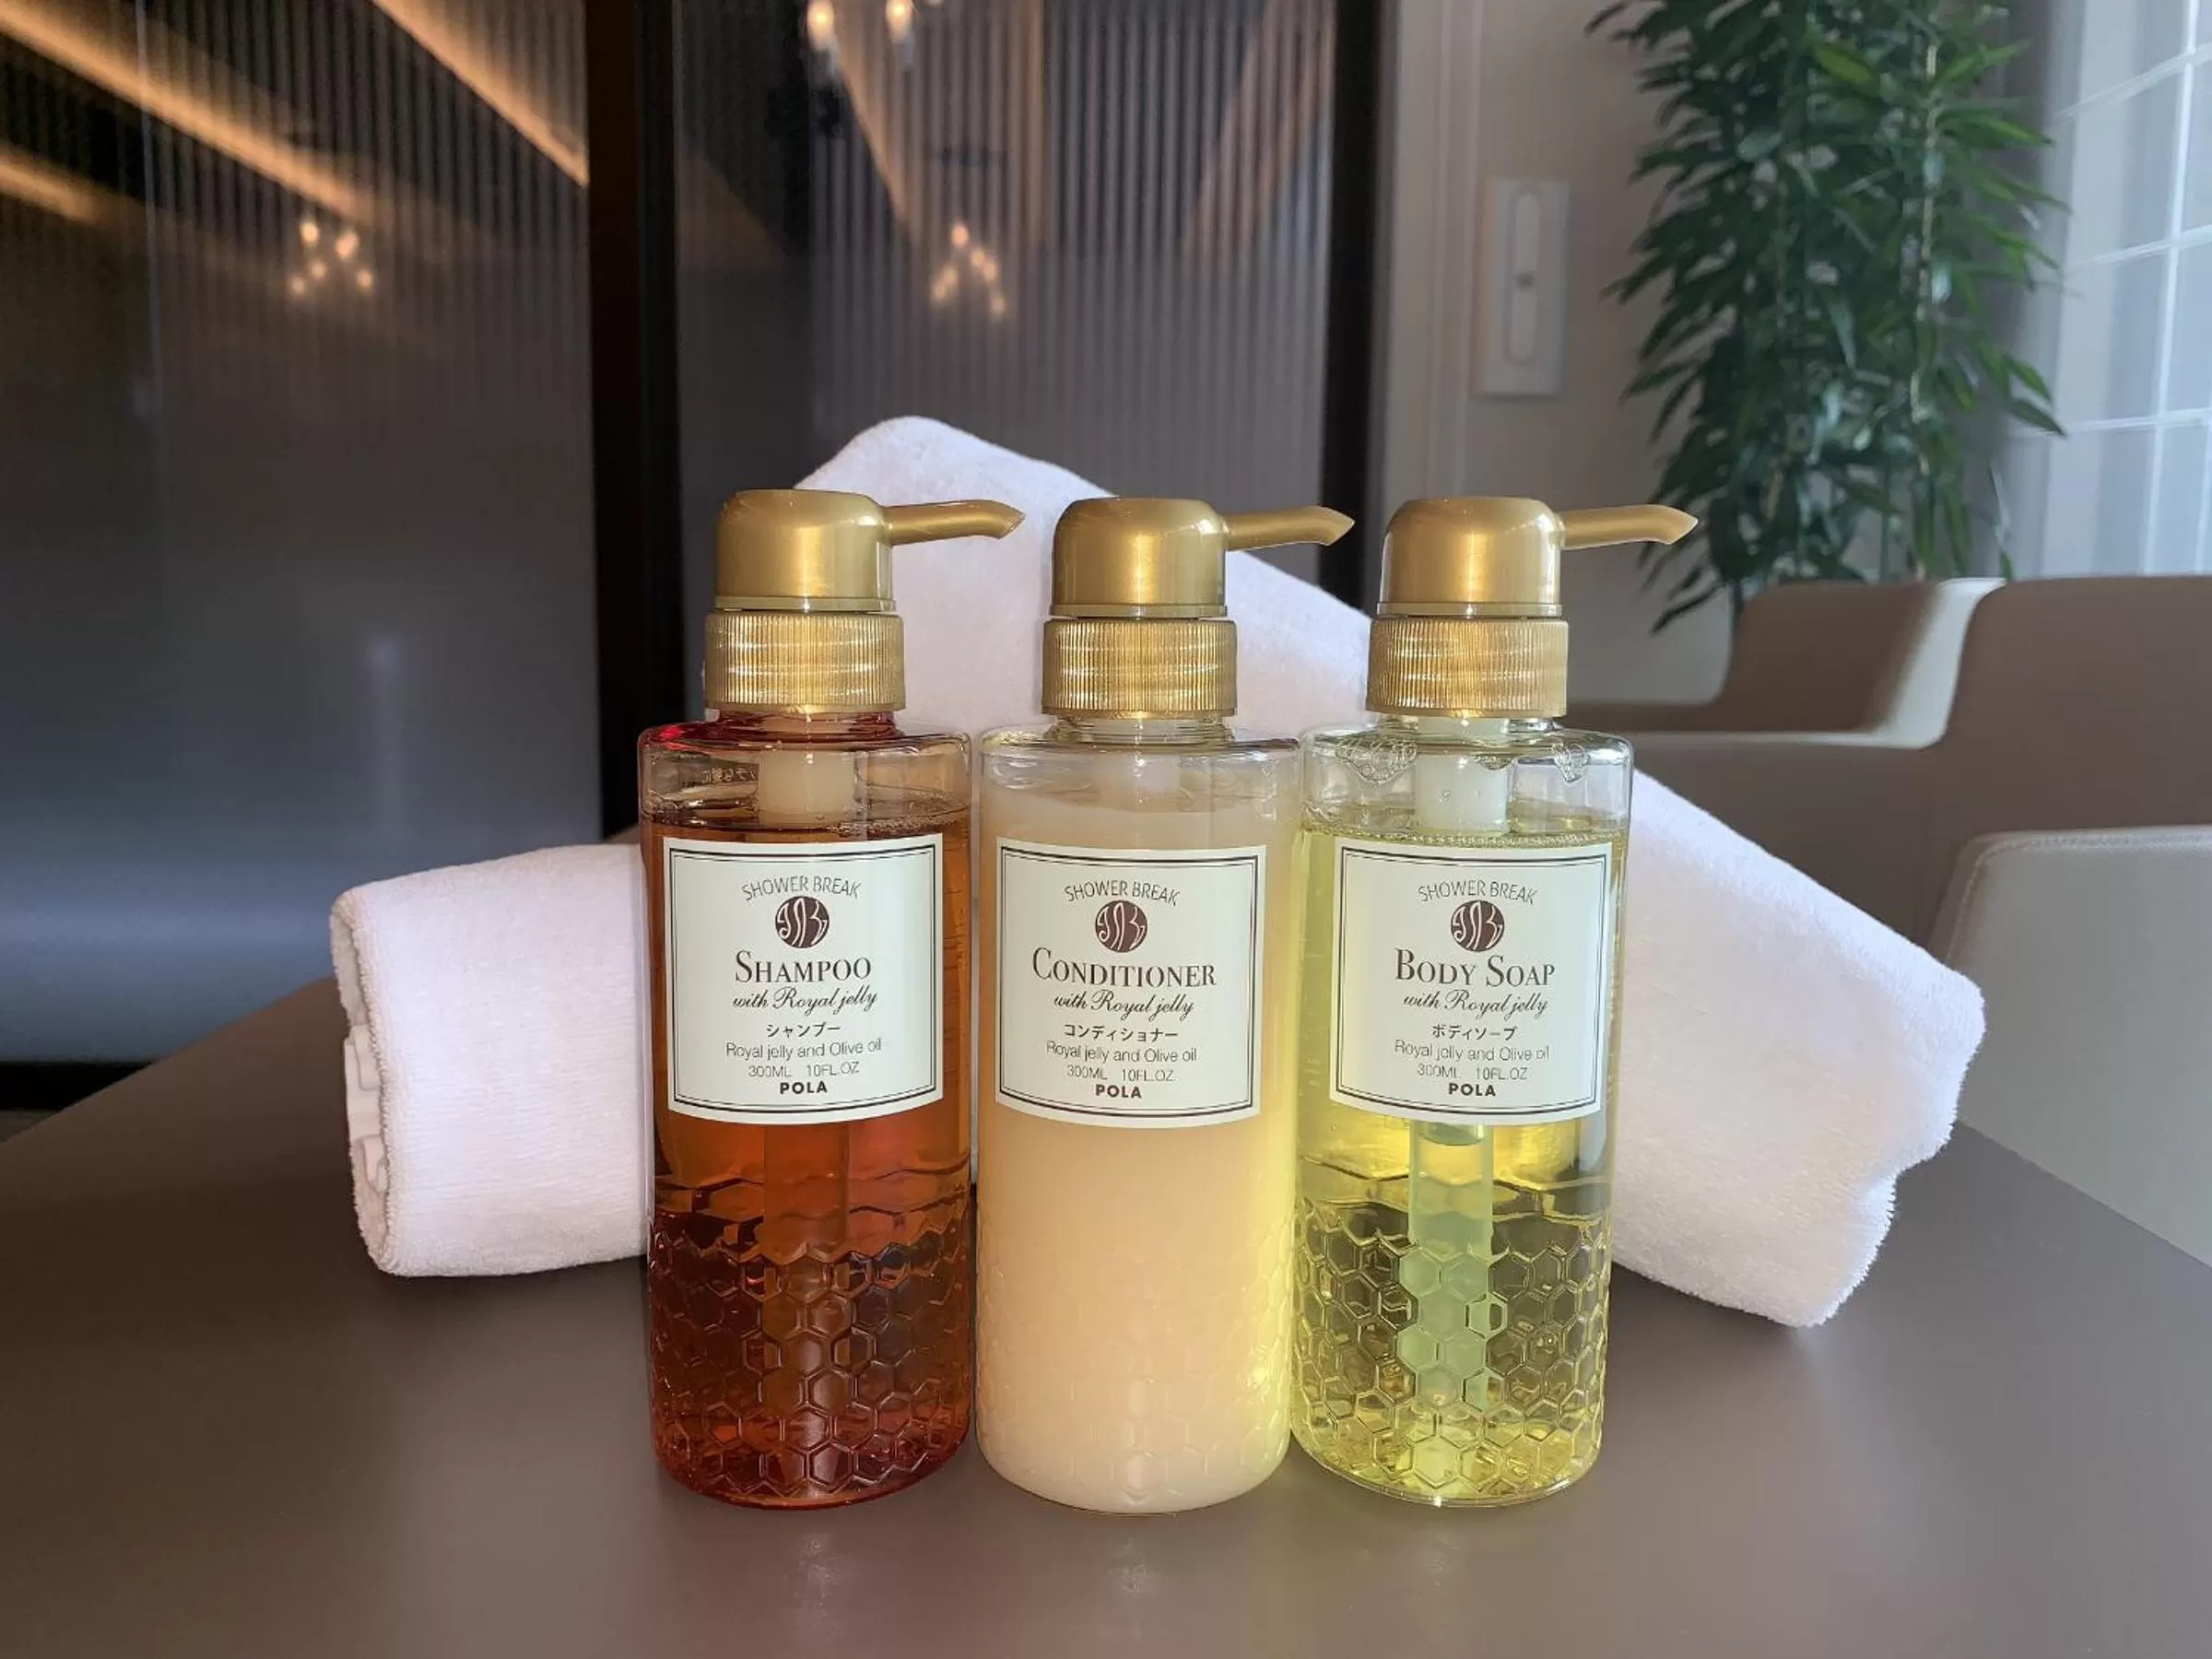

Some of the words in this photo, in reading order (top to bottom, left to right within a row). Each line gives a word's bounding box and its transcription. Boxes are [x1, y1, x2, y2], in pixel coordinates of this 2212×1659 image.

[742, 876, 808, 901] SHOWER
[813, 876, 861, 899] BREAK
[1065, 880, 1128, 901] SHOWER
[1133, 881, 1180, 906] BREAK
[1418, 880, 1486, 901] SHOWER
[1490, 881, 1536, 904] BREAK
[735, 950, 871, 983] SHAMPOO
[1032, 947, 1217, 987] CONDITIONER
[1394, 948, 1477, 985] BODY
[1486, 955, 1556, 987] SOAP
[733, 990, 769, 1007] with
[773, 986, 837, 1015] Royal
[833, 984, 877, 1015] jelly
[1053, 991, 1088, 1009] with
[1091, 989, 1155, 1021] Royal
[1148, 994, 1194, 1021] jelly
[1404, 991, 1441, 1008] with
[1445, 989, 1511, 1020] Royal
[1504, 992, 1548, 1020] jelly
[1064, 1023, 1179, 1042] コンディショナー
[726, 1042, 764, 1059] Royal
[767, 1042, 793, 1061] jelly
[797, 1043, 825, 1056] and
[830, 1041, 863, 1055] Olive
[867, 1038, 881, 1052] oil
[1047, 1041, 1081, 1059] Royal
[1084, 1045, 1109, 1063] jelly
[1113, 1048, 1139, 1062] and
[1144, 1048, 1178, 1062] Olive
[1182, 1047, 1196, 1061] oil
[1394, 1040, 1432, 1058] Royal
[1436, 1044, 1464, 1062] jelly
[1468, 1046, 1494, 1061] and
[1500, 1046, 1532, 1061] Olive
[1535, 1045, 1549, 1059] oil
[748, 1065, 792, 1077] 300ML
[1067, 1065, 1108, 1079] 300ML
[1417, 1064, 1460, 1077] 300ML
[780, 1081, 828, 1094] POLA
[1096, 1084, 1142, 1099] POLA
[1449, 1083, 1496, 1097] POLA
